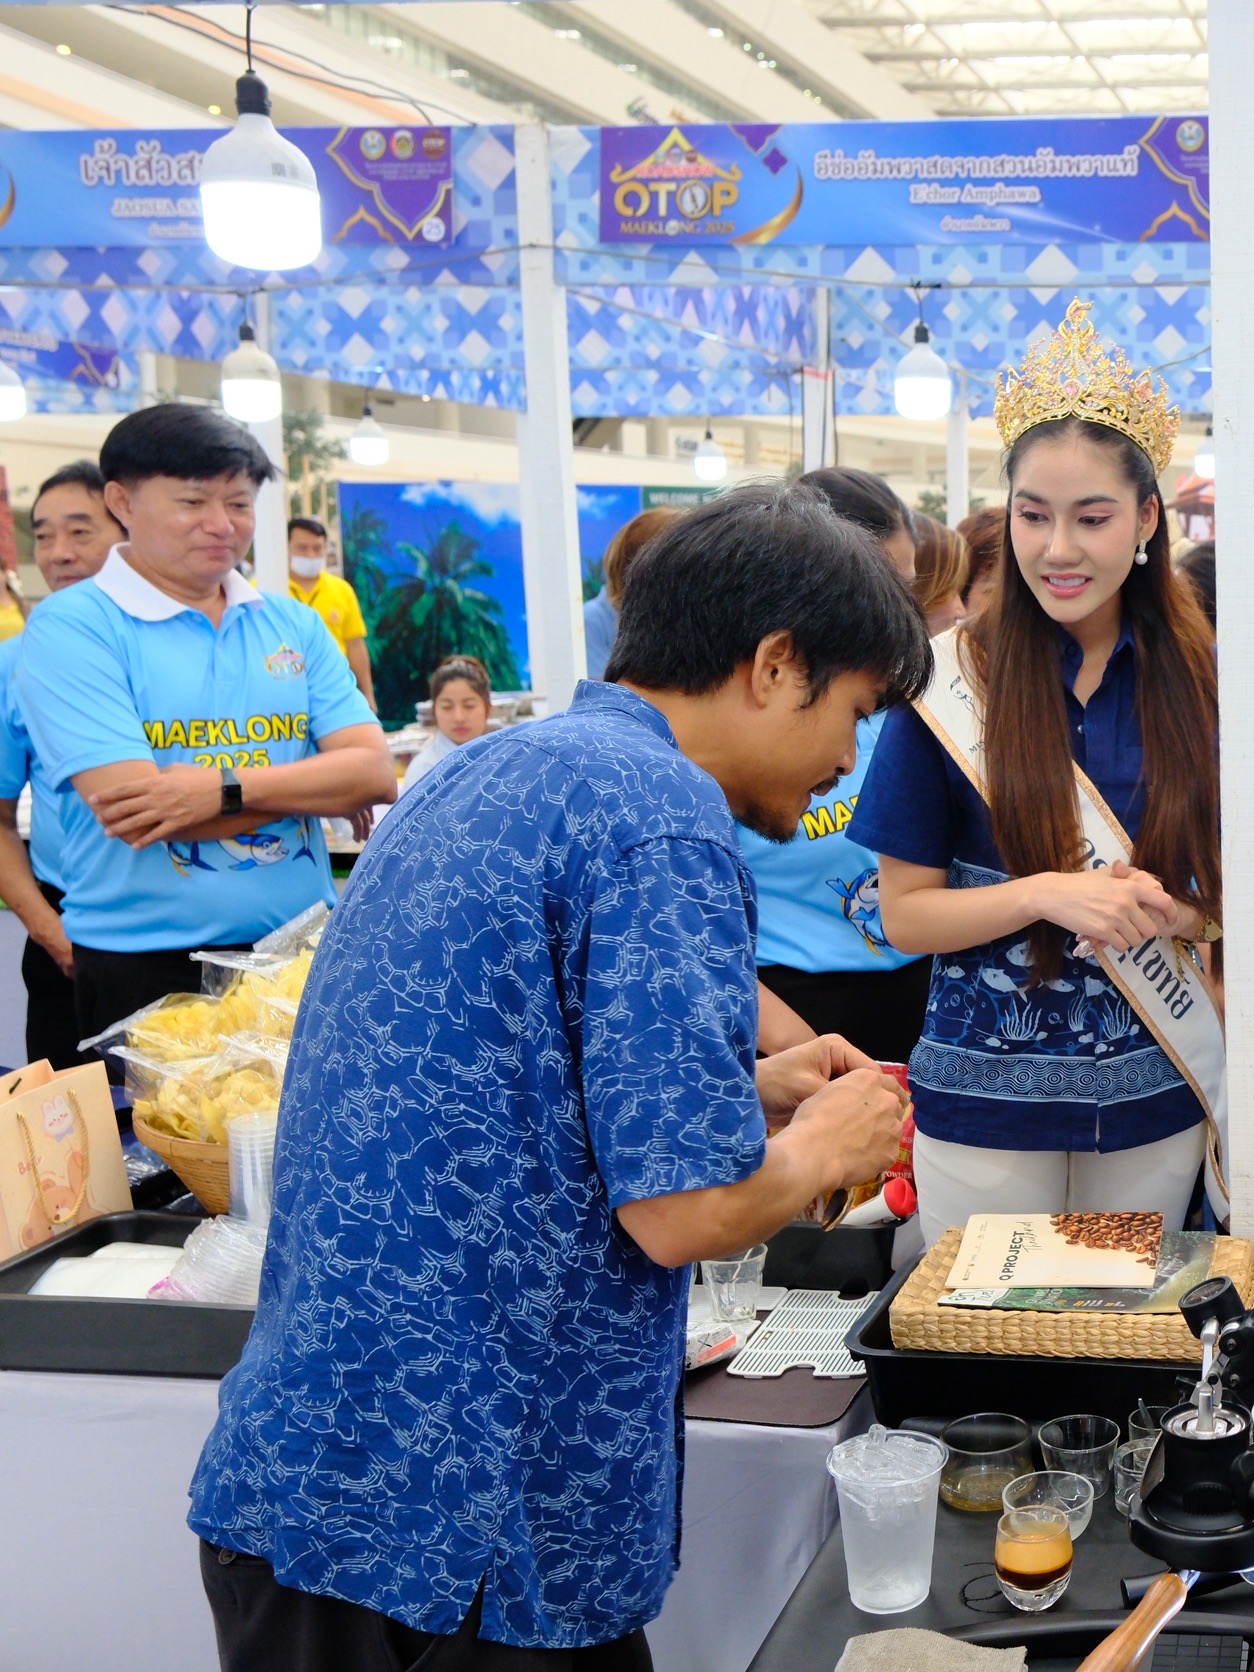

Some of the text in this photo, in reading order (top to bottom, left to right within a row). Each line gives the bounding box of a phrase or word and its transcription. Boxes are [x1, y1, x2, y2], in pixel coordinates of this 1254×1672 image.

[614, 180, 740, 219] OTOP
[961, 182, 1041, 206] Amphawa
[193, 748, 270, 769] 2025
[998, 1230, 1029, 1281] Q PROJECT
